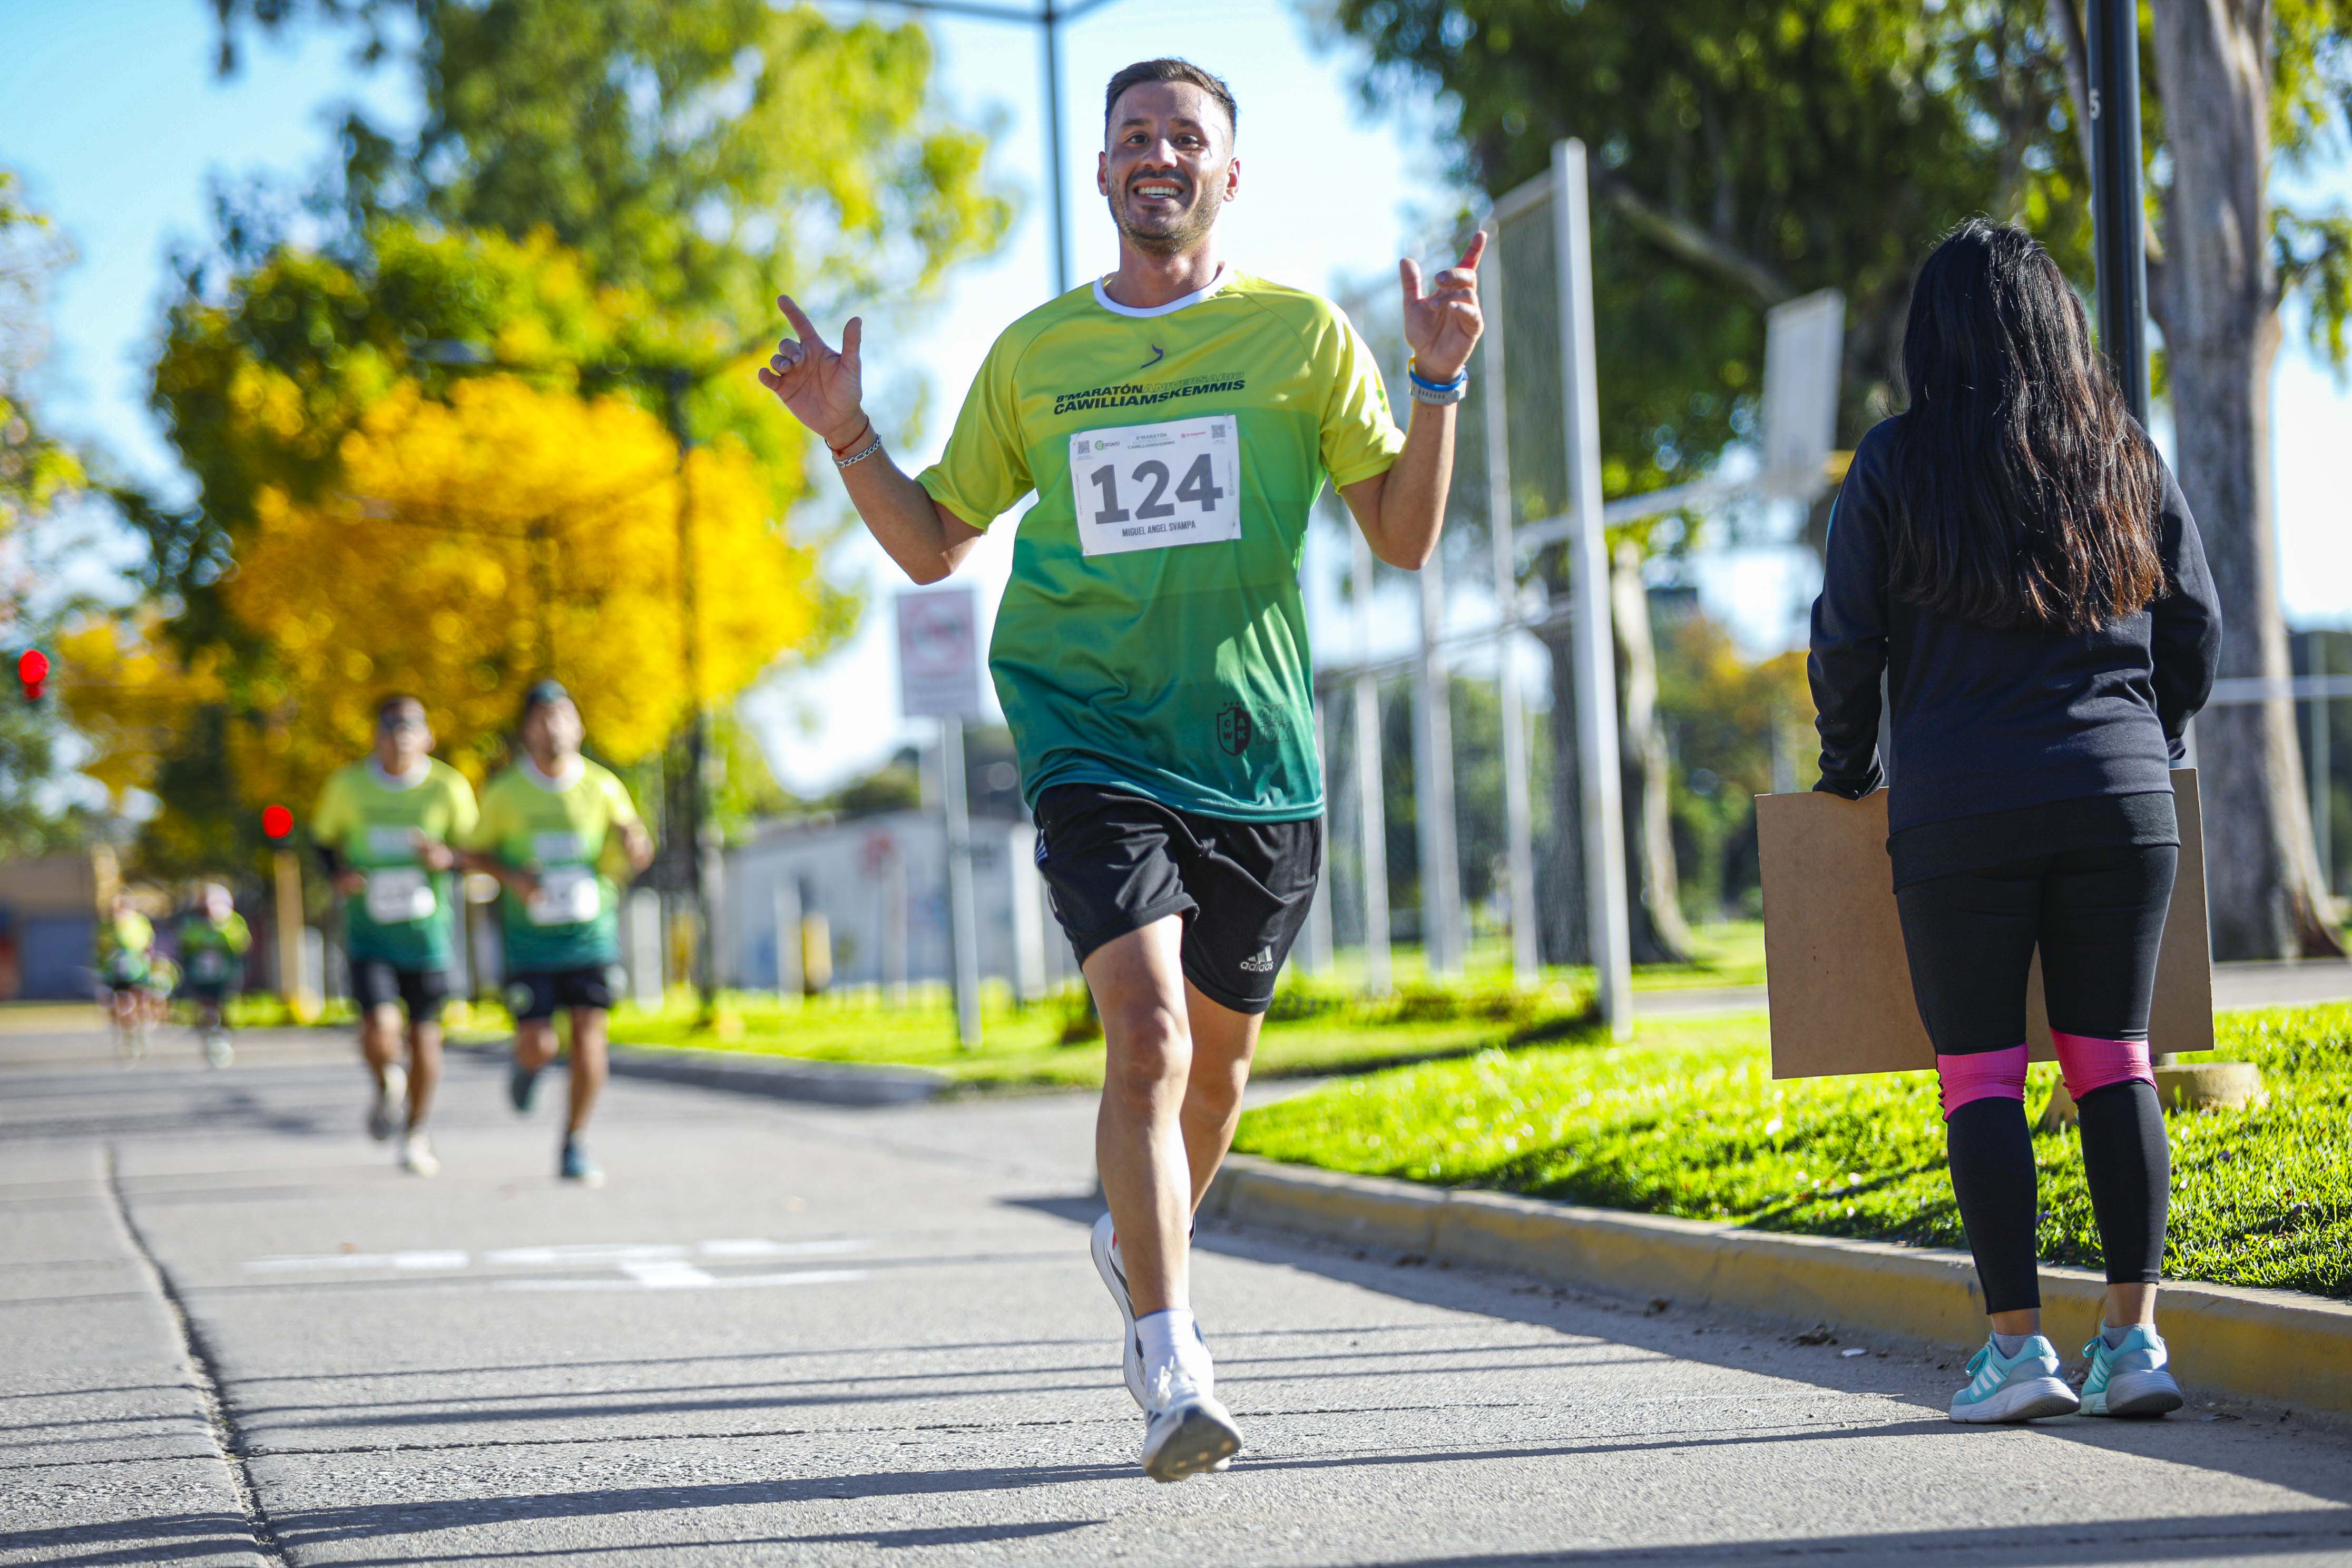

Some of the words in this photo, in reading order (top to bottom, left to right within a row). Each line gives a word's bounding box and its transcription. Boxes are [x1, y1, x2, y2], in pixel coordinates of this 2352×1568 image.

[1054, 379, 1246, 415] CAWILLIAMSKEMMIS
[1091, 453, 1223, 524] 124
[1122, 527, 1146, 537] MIGUEL
[1148, 523, 1168, 534] ANGEL
[1169, 520, 1196, 531] SVAMPA
[1240, 961, 1273, 972] adidas
